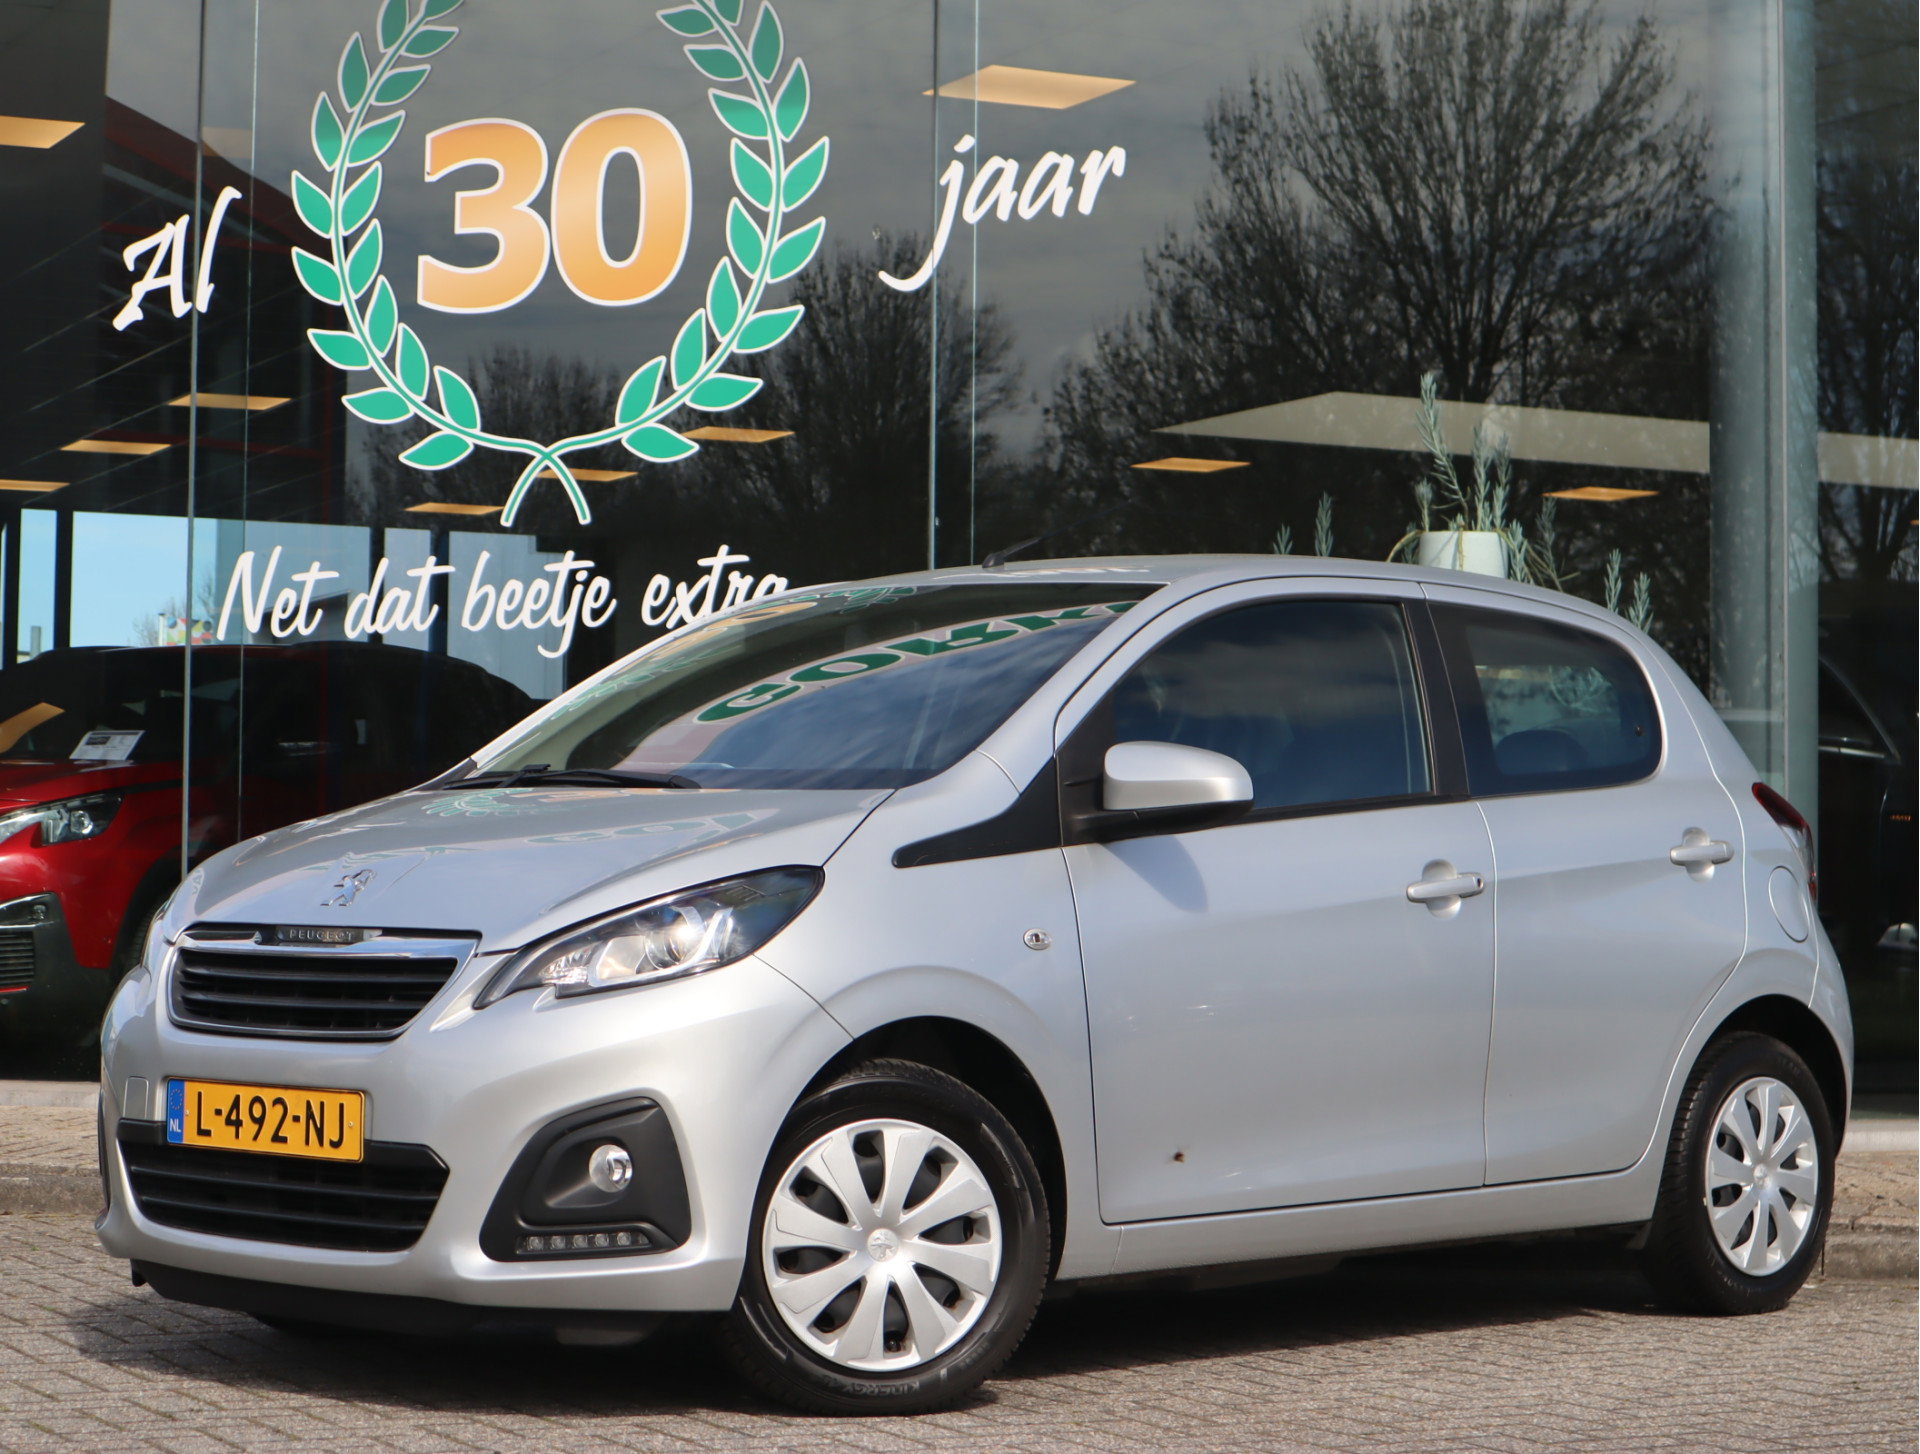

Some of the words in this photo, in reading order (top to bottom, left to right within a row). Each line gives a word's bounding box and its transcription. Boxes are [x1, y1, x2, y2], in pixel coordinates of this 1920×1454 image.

[112, 186, 243, 331] Al
[416, 106, 694, 316] 30
[878, 134, 1127, 293] jaar
[216, 545, 340, 641] Net
[344, 555, 456, 639] dat
[461, 550, 617, 659] beetje
[288, 928, 354, 942] PEUGEOT
[169, 1118, 182, 1133] NL
[196, 1091, 346, 1149] L-492-NJ
